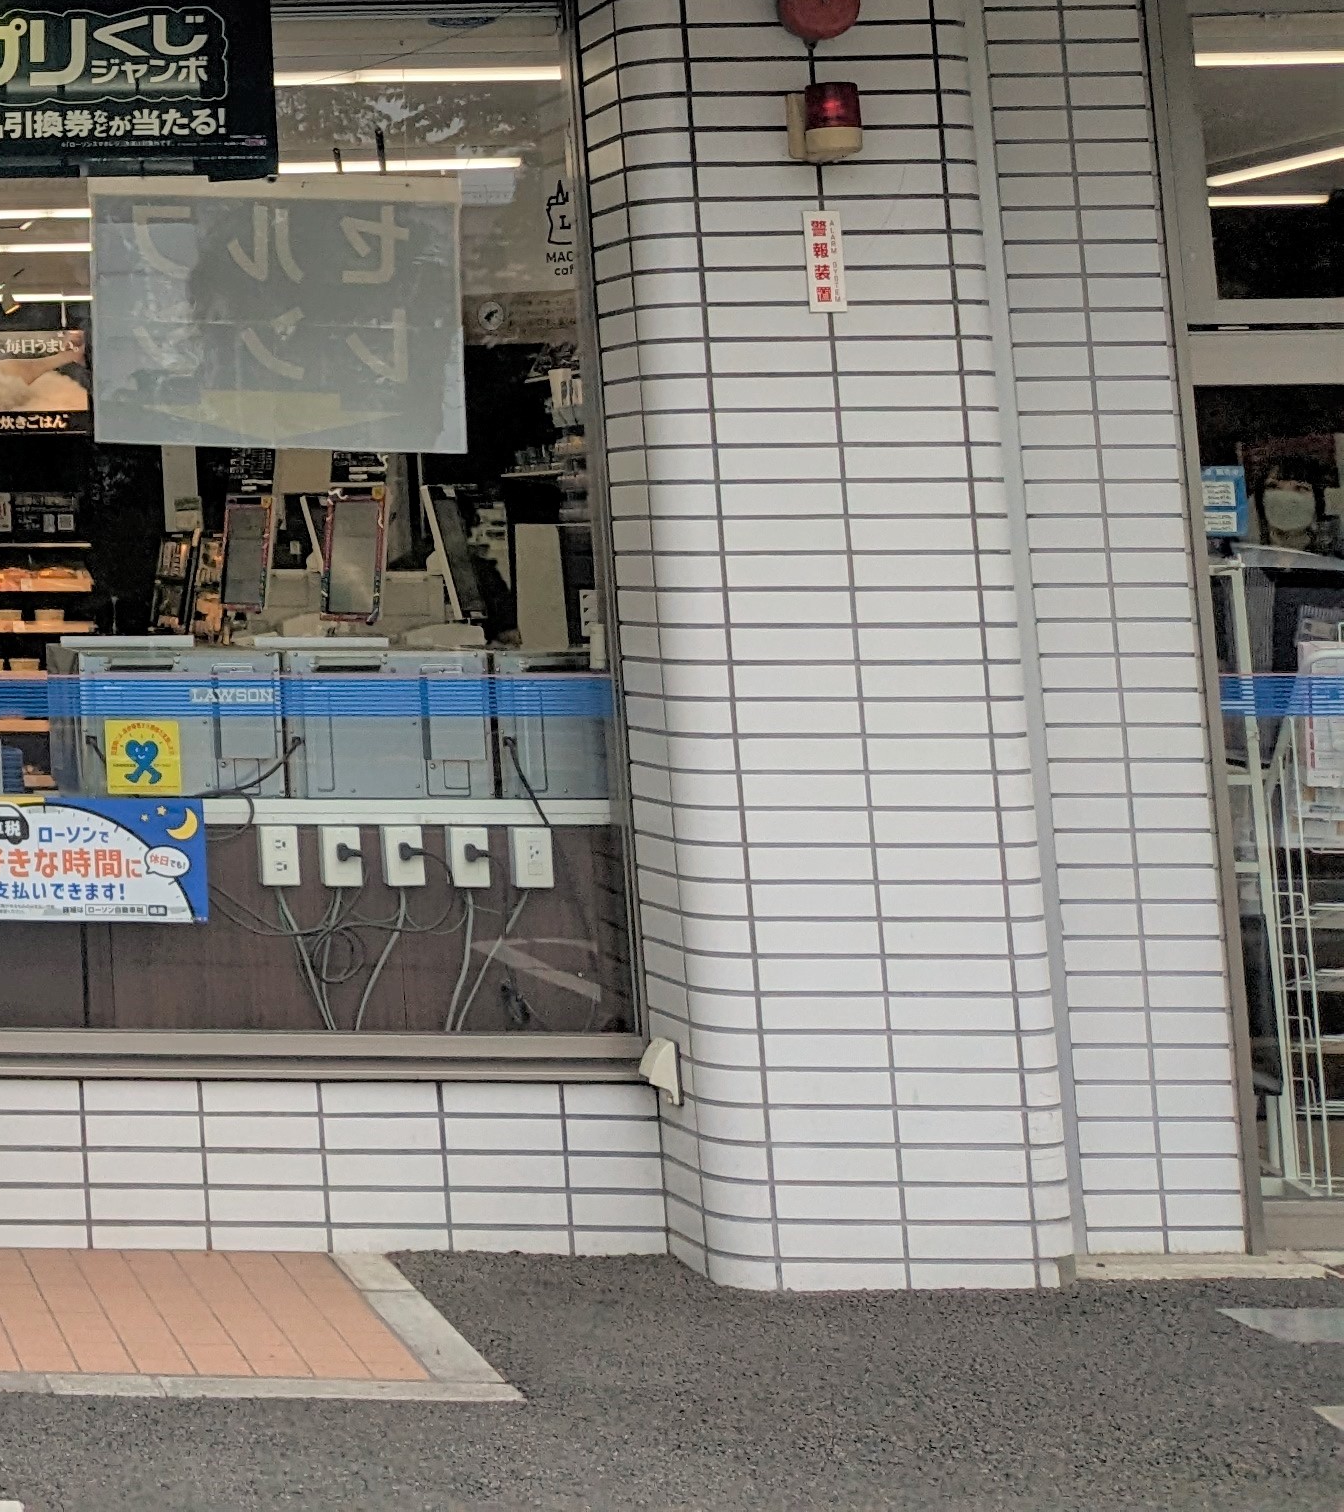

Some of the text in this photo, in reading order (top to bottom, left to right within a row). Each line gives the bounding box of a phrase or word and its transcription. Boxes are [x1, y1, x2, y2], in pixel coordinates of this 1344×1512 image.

[90, 54, 210, 85] ジャンボ
[545, 250, 574, 264] MAC
[810, 220, 832, 303] 警報装置
[554, 264, 574, 277] caf
[191, 688, 275, 703] LAWSON
[38, 825, 109, 844] ローソンで
